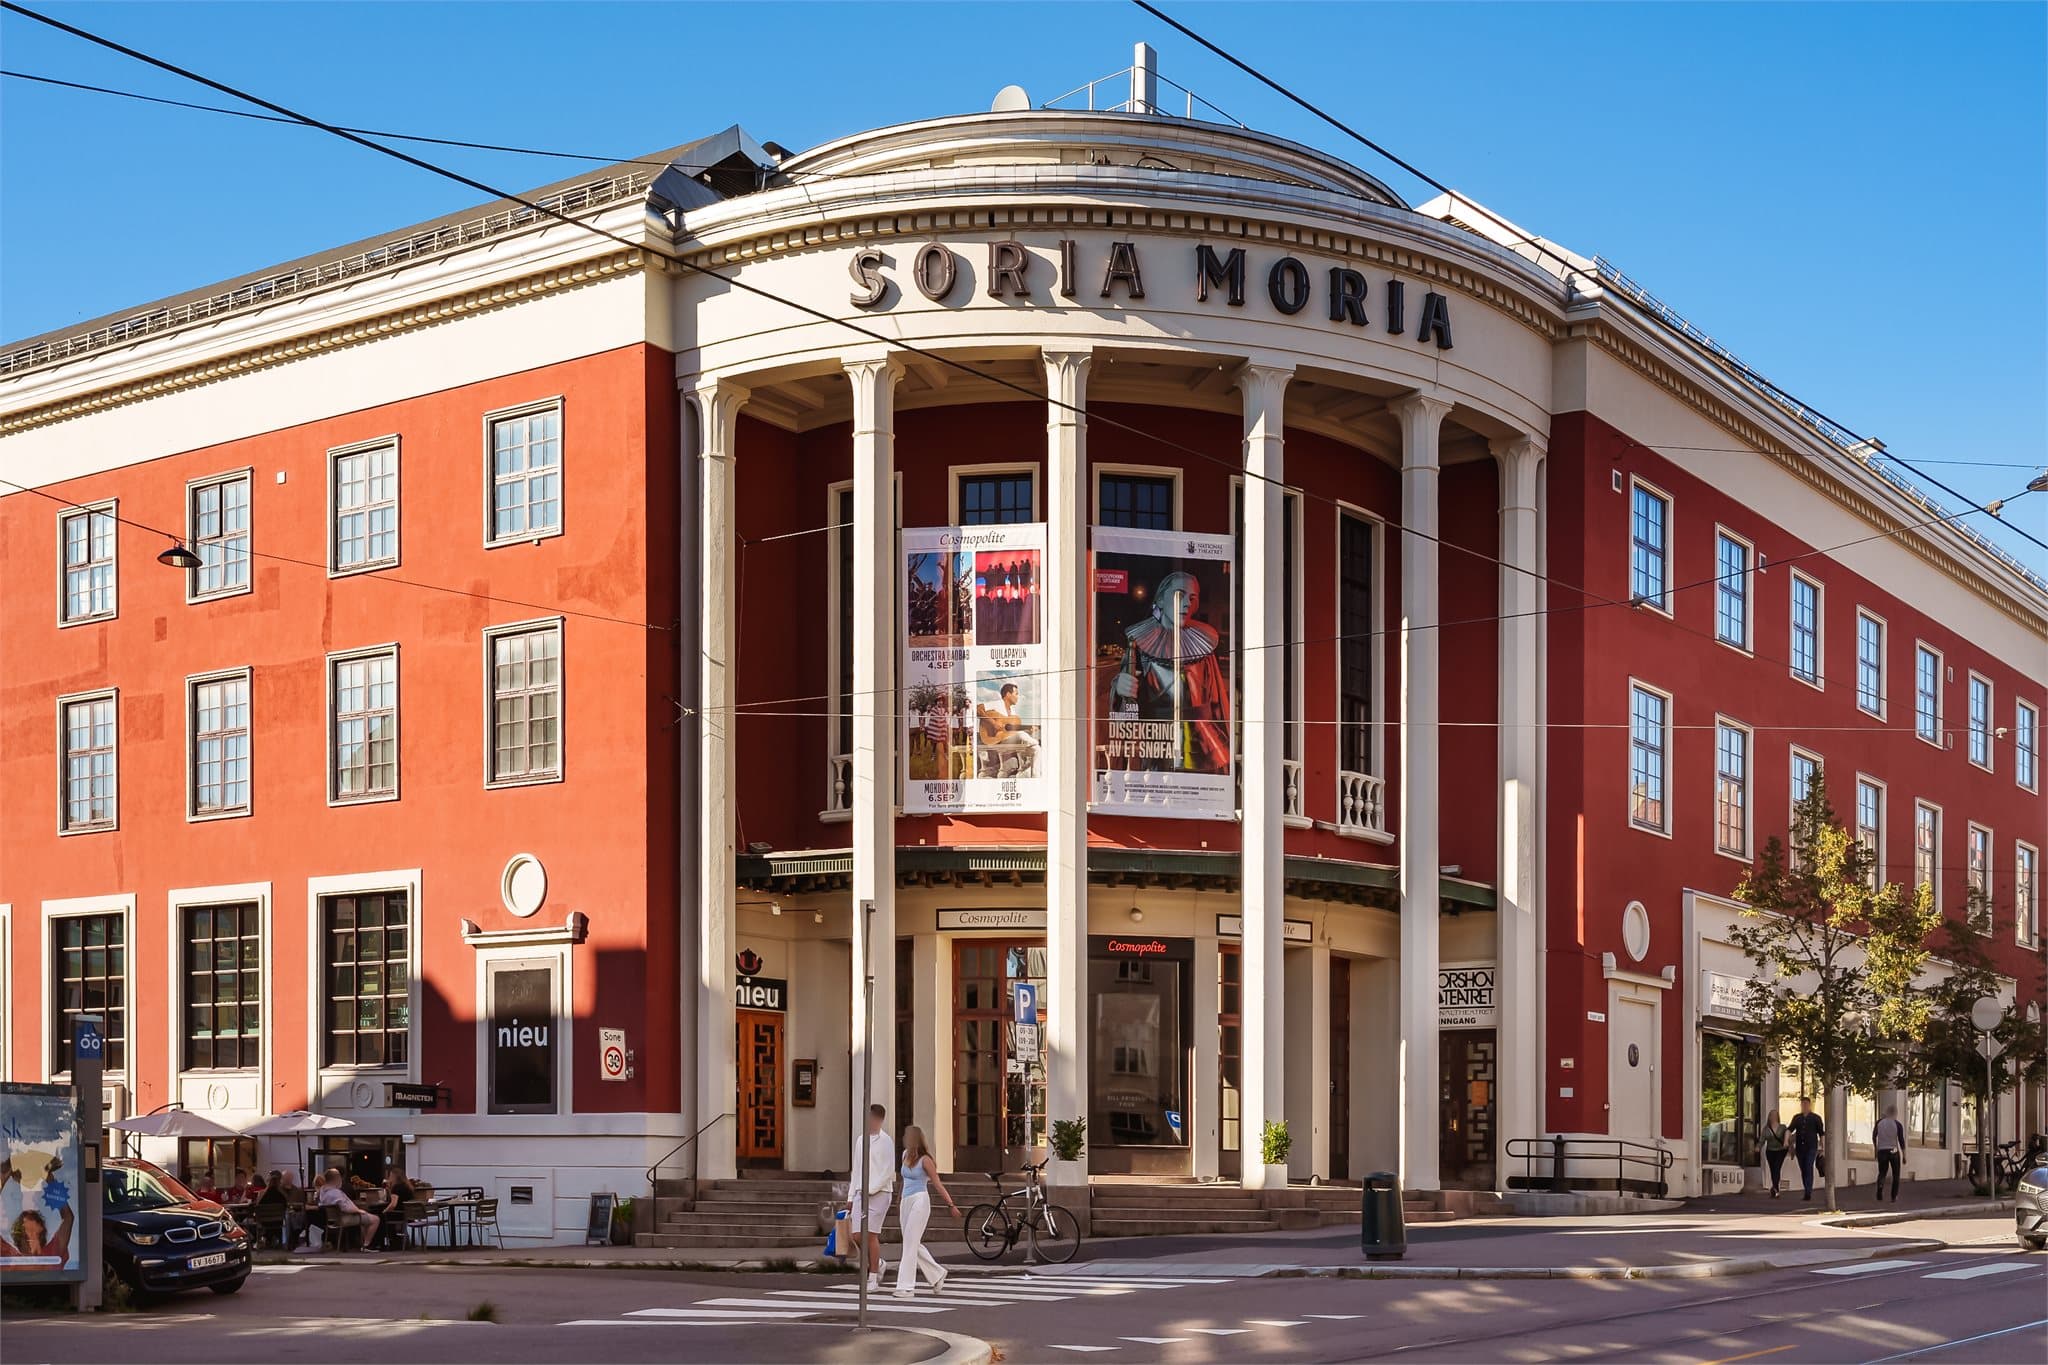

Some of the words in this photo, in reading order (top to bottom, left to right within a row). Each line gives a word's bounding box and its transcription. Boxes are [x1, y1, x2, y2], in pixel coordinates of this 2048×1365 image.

[850, 239, 1146, 307] SORIA
[1195, 243, 1454, 351] MORIA
[939, 530, 1006, 548] Cosmopolite
[911, 650, 945, 661] ORCHESTRA
[996, 659, 1022, 668] 5.SEP
[927, 661, 954, 669] 4.SEP
[1108, 740, 1122, 758] AV
[1124, 741, 1137, 758] ET
[928, 794, 955, 802] 6.SEP
[959, 912, 1028, 926] Cosmopolite
[1108, 940, 1167, 957] Cosmopolite
[1019, 989, 1031, 1019] P
[498, 1018, 548, 1048] nieu
[603, 1031, 622, 1042] Sone
[607, 1053, 620, 1069] 30
